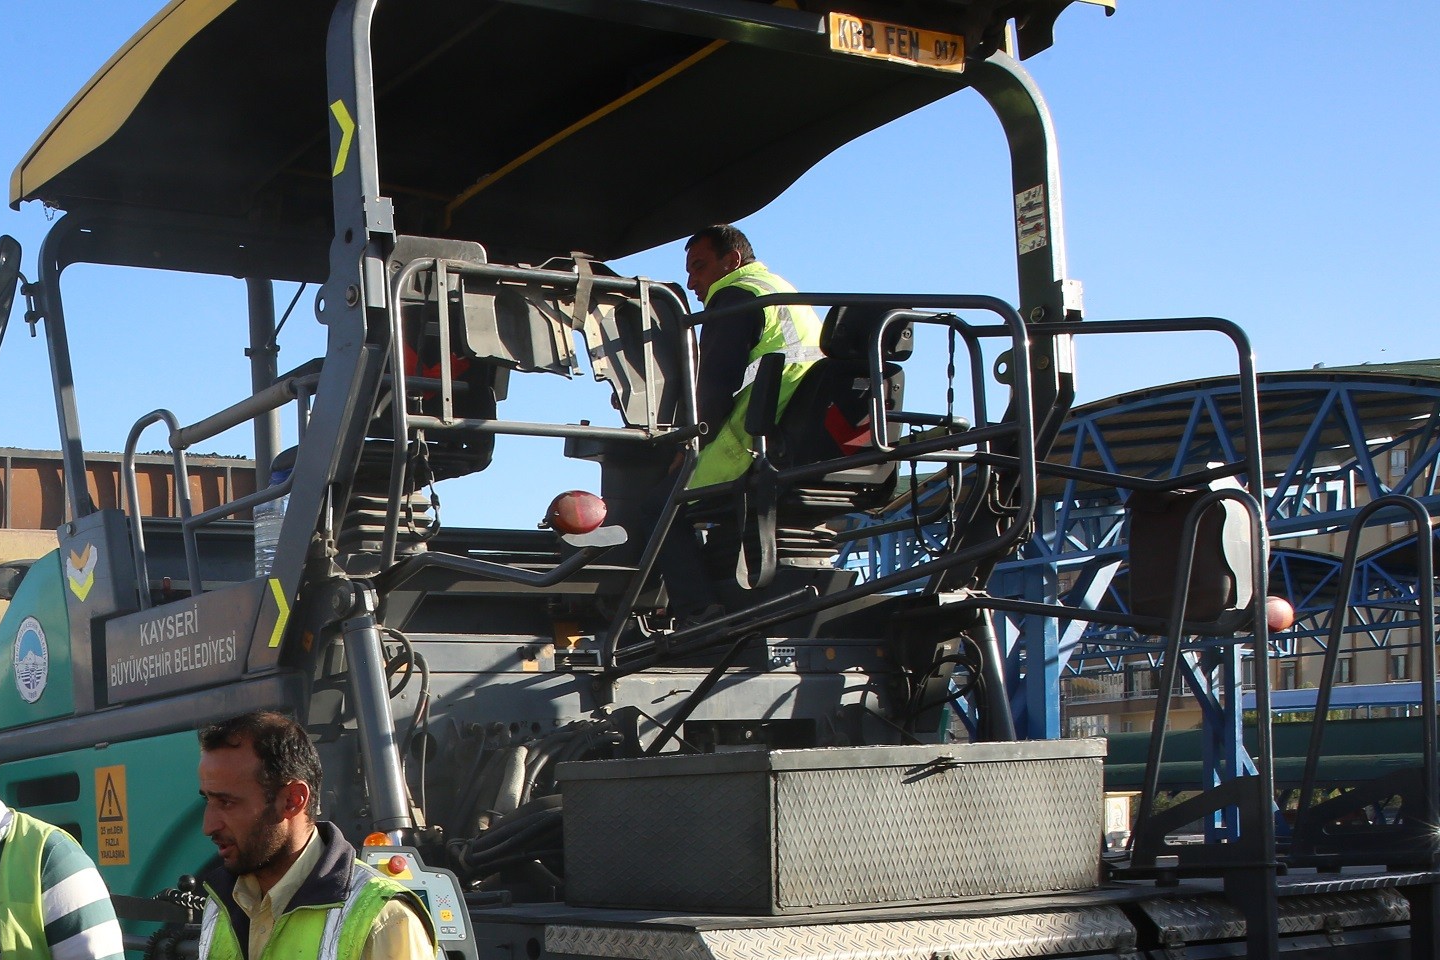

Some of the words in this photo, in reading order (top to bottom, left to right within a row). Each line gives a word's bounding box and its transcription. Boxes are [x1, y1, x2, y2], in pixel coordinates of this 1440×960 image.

[838, 17, 876, 51] KBB
[885, 26, 920, 62] FEN
[140, 603, 199, 647] KAYSERİ
[110, 647, 173, 687] BÜYÜKŞEHİR
[174, 630, 237, 674] BELEDİYESİ
